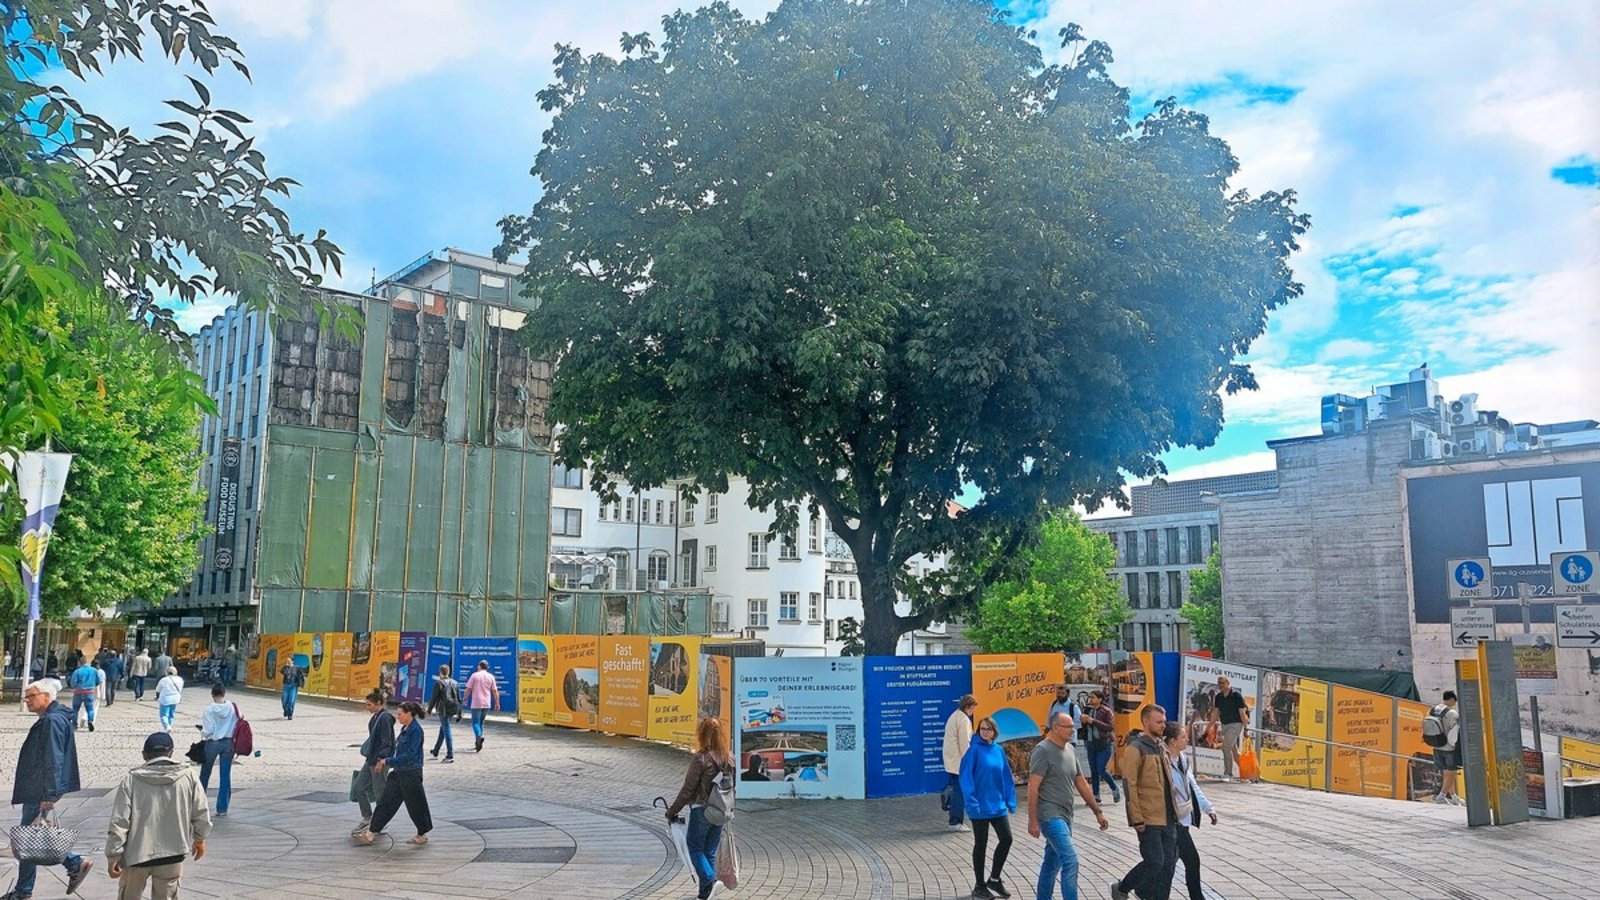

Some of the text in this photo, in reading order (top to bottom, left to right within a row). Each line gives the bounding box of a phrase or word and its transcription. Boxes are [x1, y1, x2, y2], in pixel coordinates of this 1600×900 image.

[218, 477, 229, 535] FOOD MUSEUM
[227, 482, 237, 530] DISGUSTING
[1459, 589, 1482, 597] ZONE
[1565, 584, 1590, 593] ZONE
[615, 643, 632, 656] Fast
[602, 657, 645, 673] geschafft!
[740, 674, 758, 683] ÜBER
[1186, 663, 1257, 683] DIE APP FÜR STUTTGART
[804, 684, 857, 692] ERLEBNISCARD!
[988, 678, 1005, 691] LASS
[1007, 675, 1022, 687] DEN
[1006, 690, 1014, 701] IN
[1016, 687, 1033, 699] DEIN
